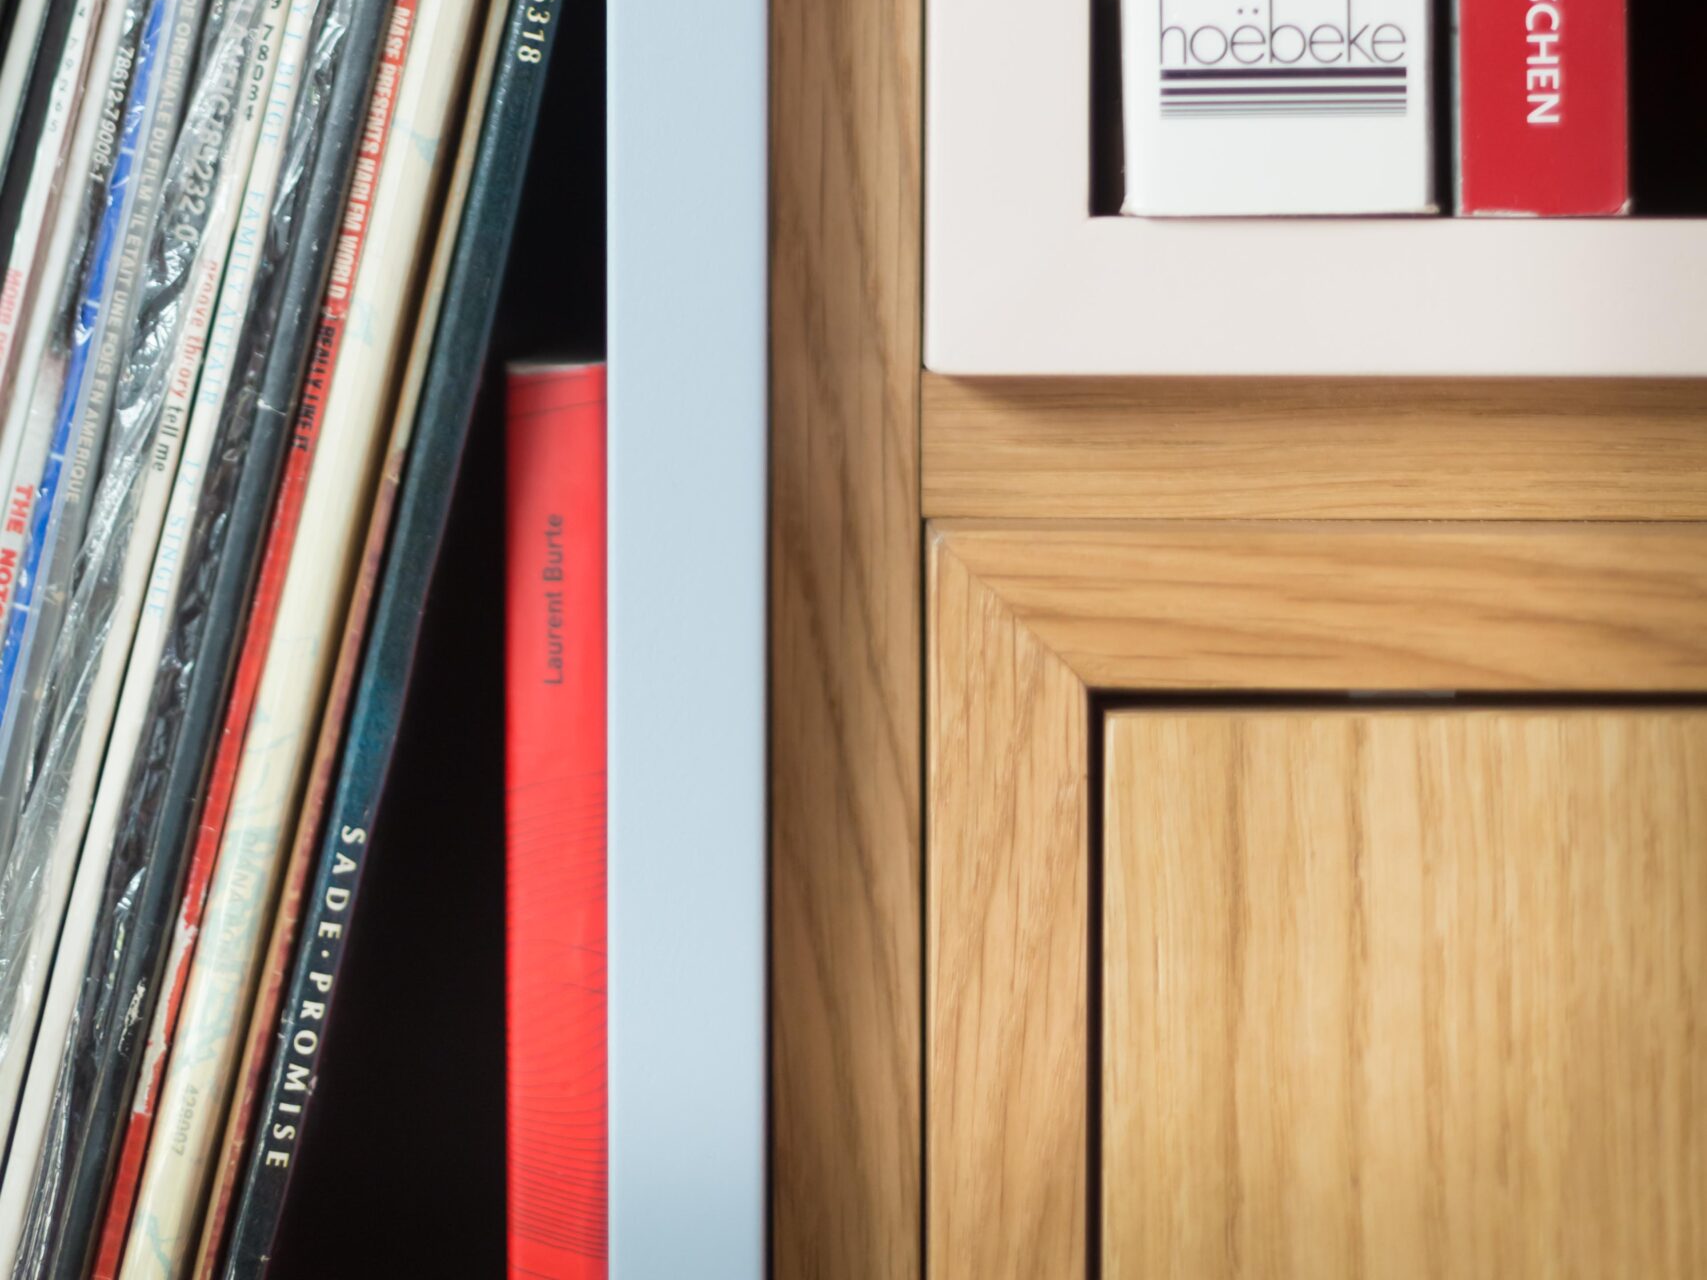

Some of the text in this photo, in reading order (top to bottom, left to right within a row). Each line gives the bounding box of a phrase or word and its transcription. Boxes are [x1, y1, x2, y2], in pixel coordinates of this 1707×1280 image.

[385, 6, 411, 58] MASE
[155, 22, 192, 125] ORIGINALE
[262, 63, 297, 144] BLIGE
[89, 46, 136, 183] 78612-79006-1
[149, 127, 167, 153] DU
[361, 63, 397, 154] PRESENTS
[137, 156, 161, 201] FILM
[343, 158, 376, 230] HARLEM
[202, 190, 265, 405] FAMILY AFFAIR
[328, 234, 359, 299] WORLD
[107, 290, 129, 329] UNE
[98, 331, 119, 375] FOIS
[306, 324, 336, 390] REALLY
[89, 378, 108, 404] EN
[160, 404, 184, 438] tell
[297, 394, 321, 431] LIKE
[152, 442, 170, 472] me
[6, 483, 36, 536] THE
[148, 516, 186, 616] SINGLE
[543, 514, 565, 685] Laurent Burte
[265, 824, 367, 1168] SADE PROMISE
